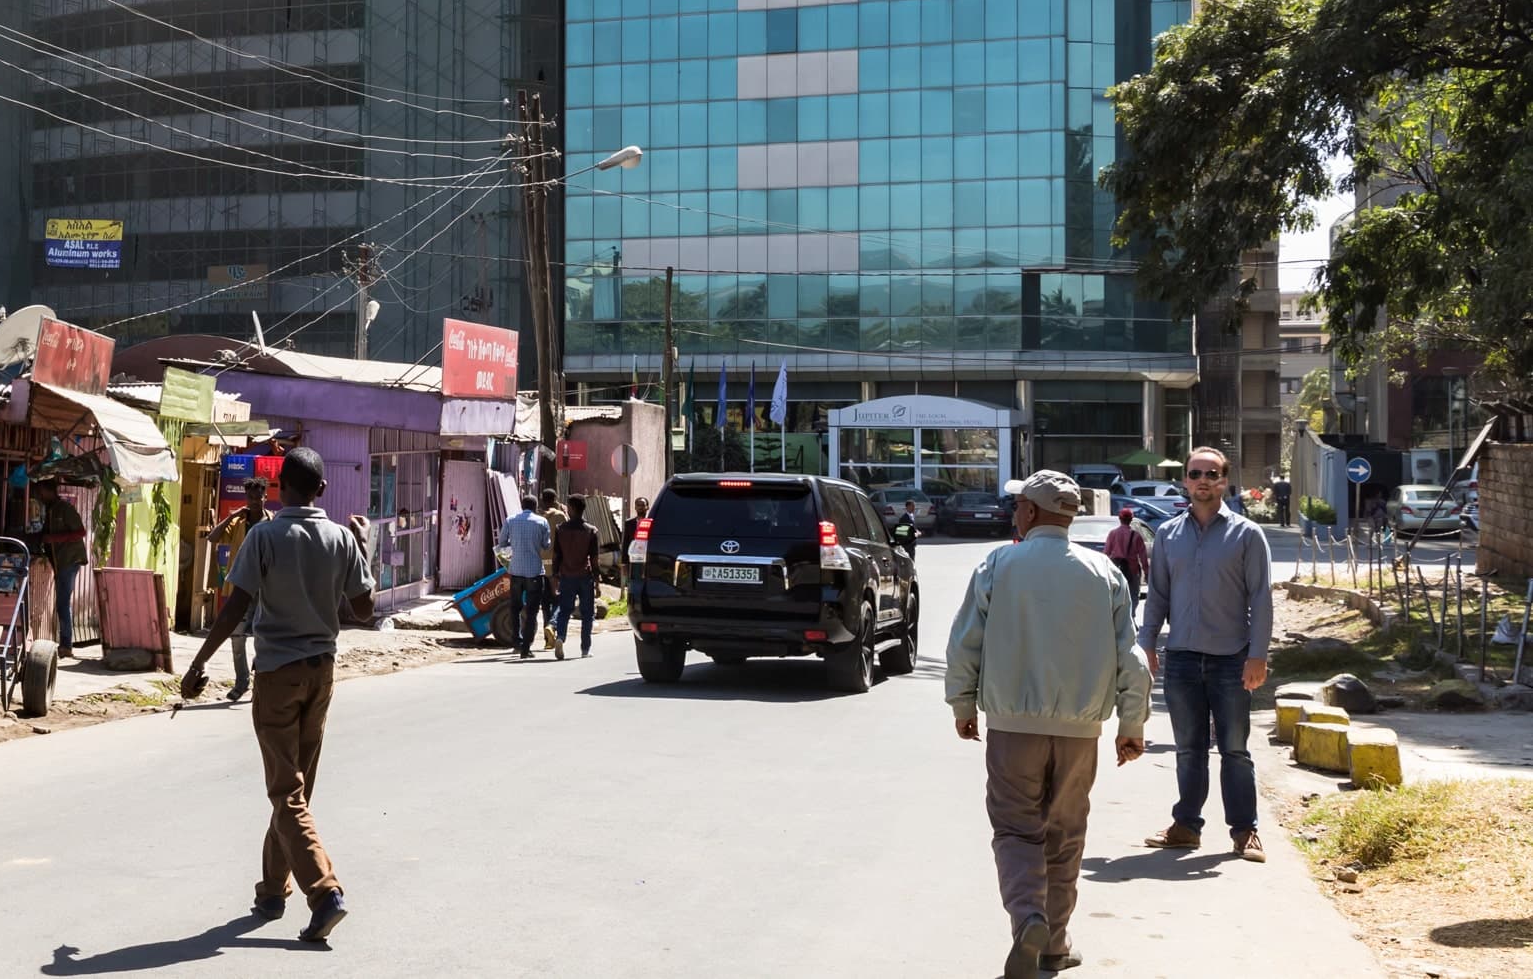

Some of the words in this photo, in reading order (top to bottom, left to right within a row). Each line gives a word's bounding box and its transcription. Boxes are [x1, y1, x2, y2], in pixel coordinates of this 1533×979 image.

[64, 240, 84, 250] ASAL
[48, 248, 90, 258] Aluminum
[91, 250, 118, 258] works
